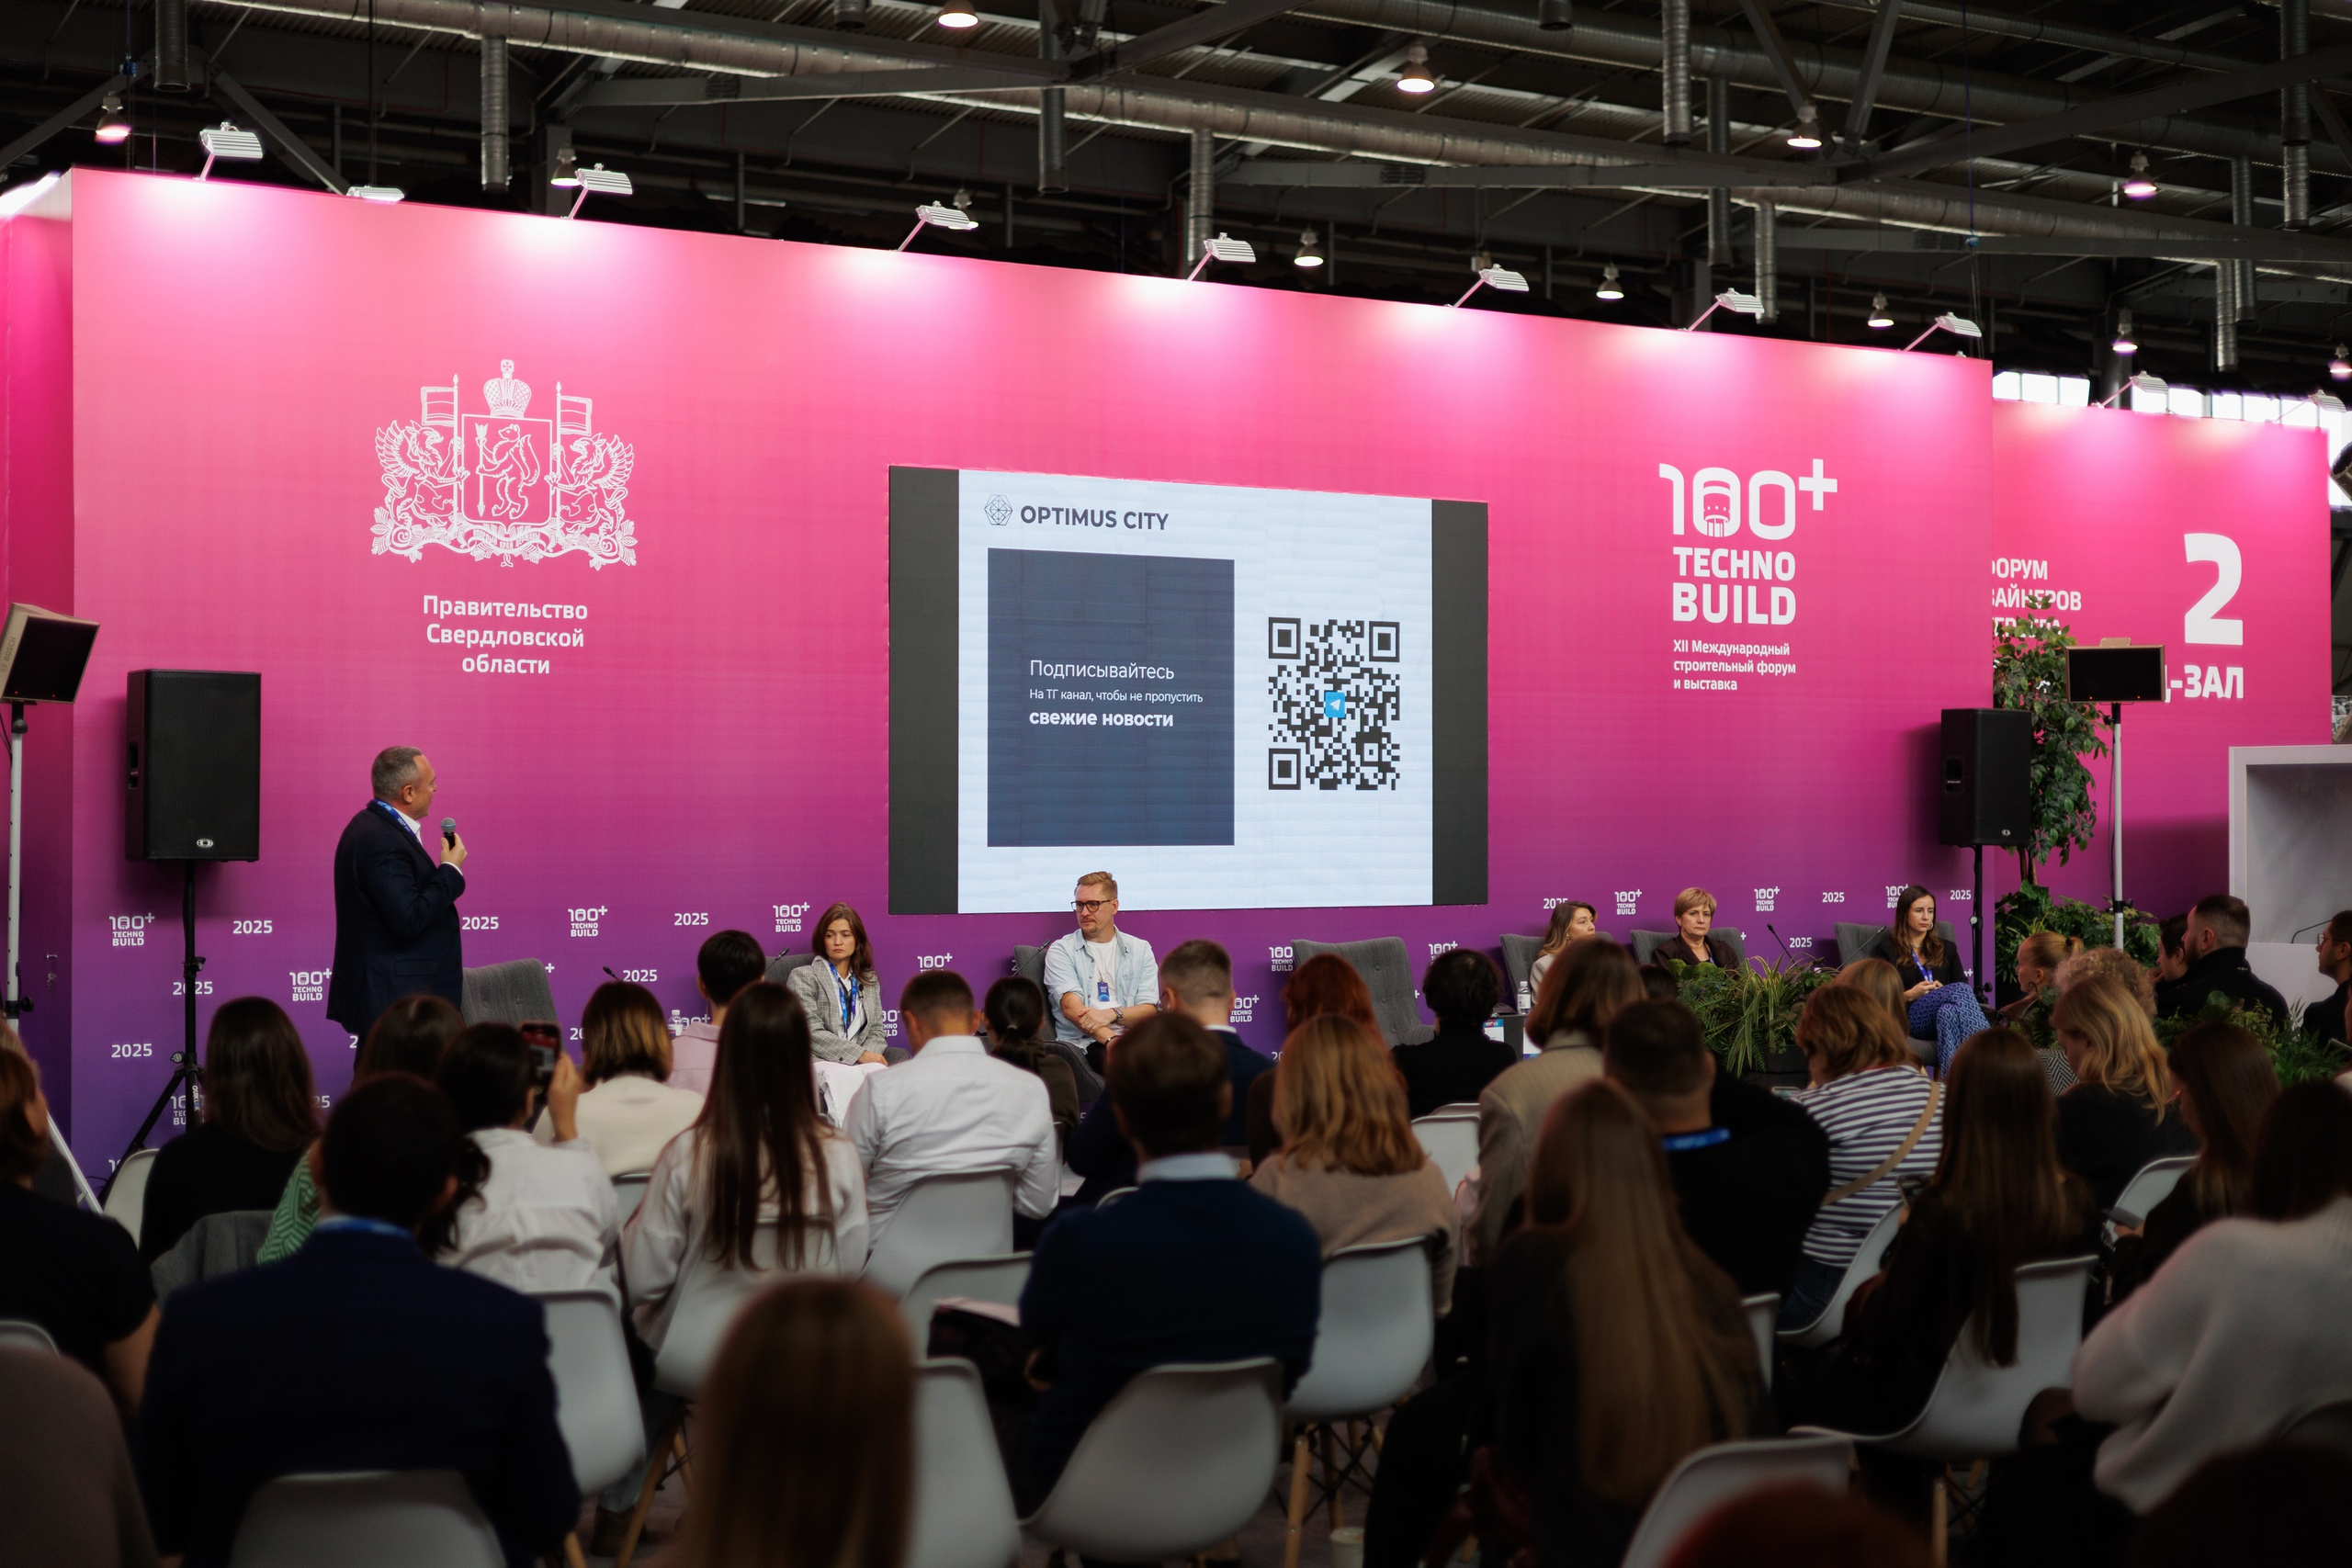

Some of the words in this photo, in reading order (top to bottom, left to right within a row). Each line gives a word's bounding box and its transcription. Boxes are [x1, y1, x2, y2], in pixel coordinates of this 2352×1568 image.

[1659, 458, 1838, 540] 100+
[1021, 505, 1117, 528] OPTIMUS
[1123, 511, 1169, 530] CITY
[1673, 547, 1795, 581] TECHNO
[1992, 582, 2082, 611] АЙНЕРОВ
[2184, 533, 2244, 646] 2
[423, 595, 588, 620] Правительство
[1673, 582, 1796, 625] BUILD
[426, 623, 584, 649] Свердловской
[1692, 639, 1790, 657] Международный
[462, 653, 550, 674] области
[1030, 660, 1174, 680] Подписывайтесь
[1674, 660, 1754, 674] строительный
[1757, 660, 1796, 676] форум
[1674, 680, 1680, 689] и
[1684, 680, 1737, 690] выставка
[2165, 664, 2244, 703] -ЗАЛ
[1029, 689, 1045, 699] На
[1046, 689, 1058, 699] ТГ
[1060, 691, 1094, 702] канал,
[1096, 690, 1127, 701] чтобы
[1129, 693, 1143, 701] не
[1145, 693, 1204, 704] пропустить
[1029, 711, 1098, 726] свежие
[1102, 713, 1174, 727] новости
[1615, 889, 1643, 903] 100+
[1754, 886, 1780, 900] 100+
[1822, 891, 1845, 903] 2025
[1950, 889, 1972, 900] 2025
[568, 906, 607, 922] 100+
[773, 902, 810, 918] 100+
[109, 912, 155, 931] 100+
[232, 919, 273, 934] 2025
[461, 917, 499, 931] 2025
[674, 912, 708, 926] 2025
[571, 929, 598, 937] BUILD
[775, 924, 801, 932] BUILD
[112, 938, 144, 946] BUILD
[1790, 936, 1812, 948] 2025
[1269, 946, 1294, 959] 100
[917, 953, 953, 969] 100+
[289, 968, 333, 986] 100+
[622, 969, 658, 982] 2025
[173, 981, 213, 995] 225
[292, 993, 322, 1001] BUILD
[1234, 994, 1260, 1010] 00+
[111, 1043, 153, 1057] 2025
